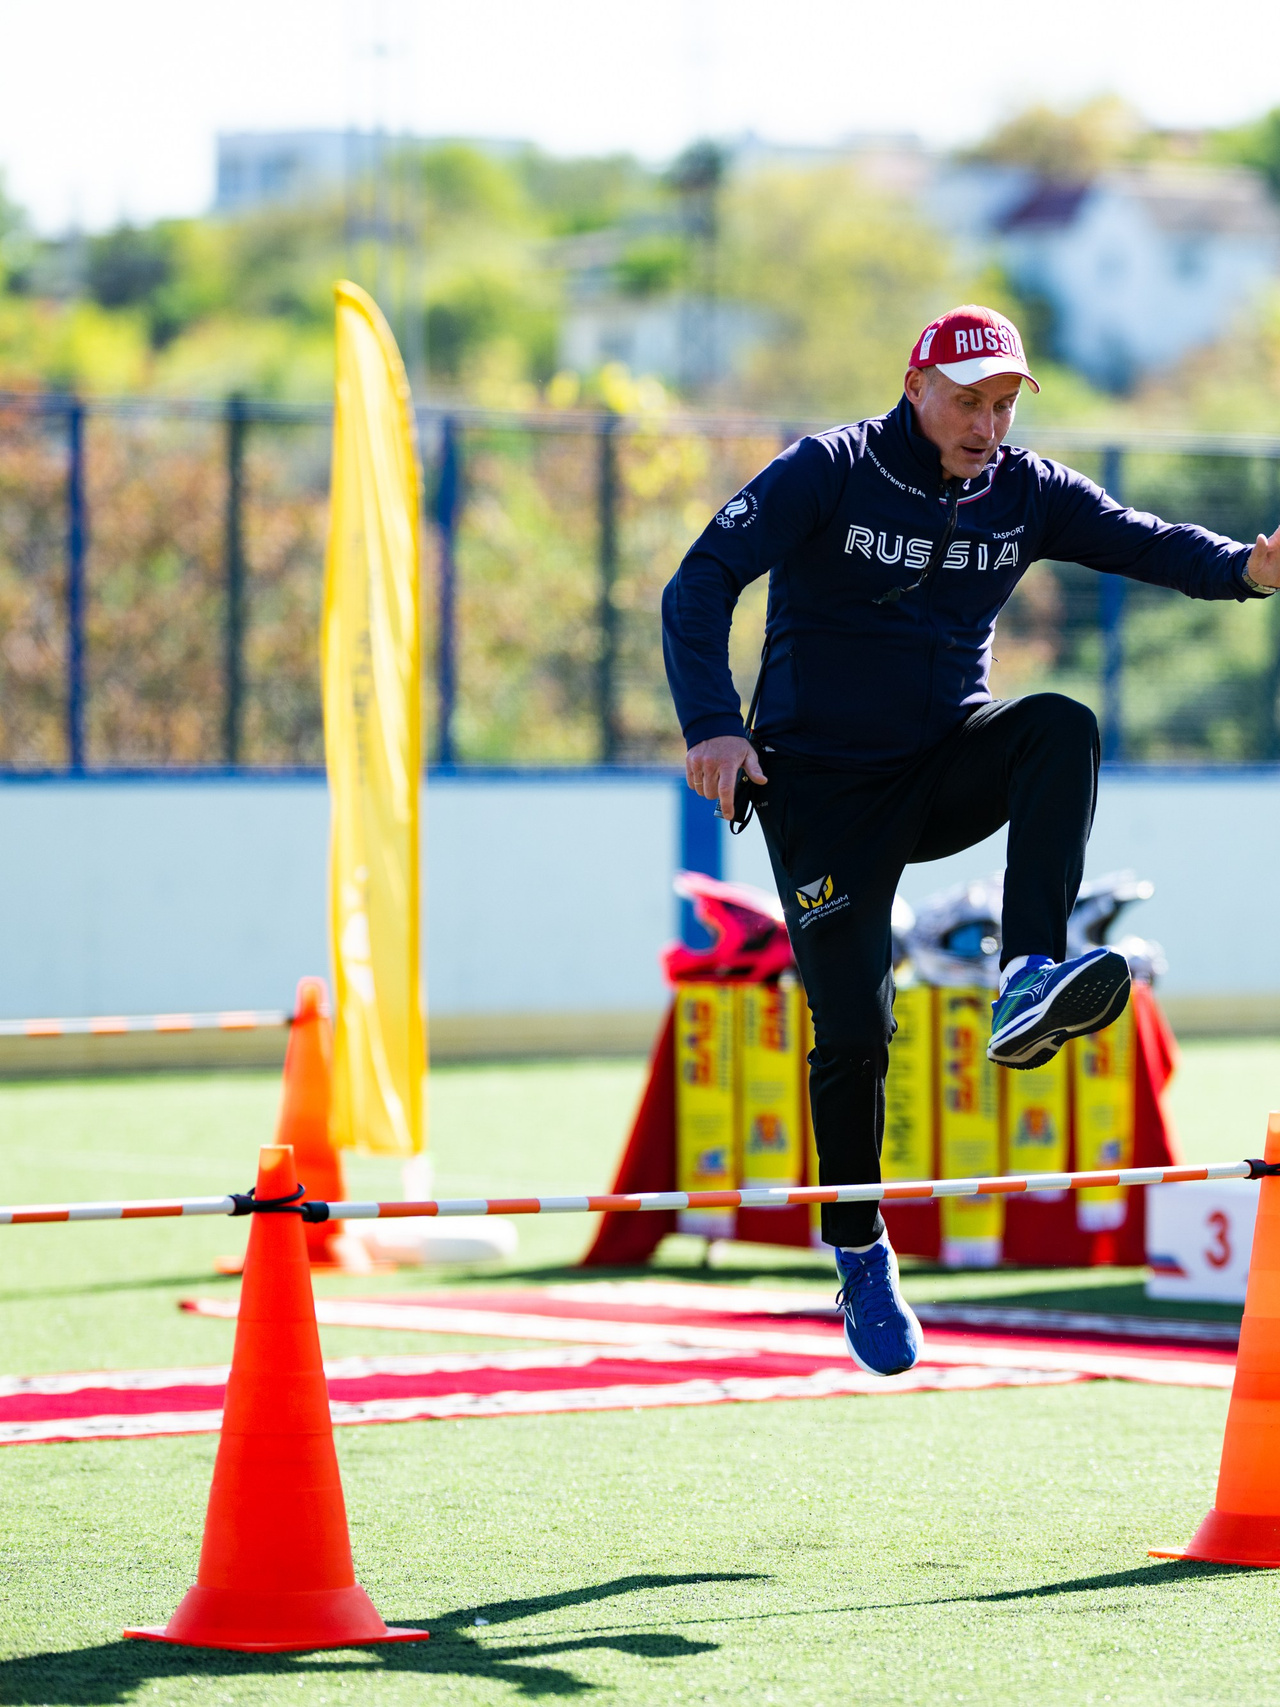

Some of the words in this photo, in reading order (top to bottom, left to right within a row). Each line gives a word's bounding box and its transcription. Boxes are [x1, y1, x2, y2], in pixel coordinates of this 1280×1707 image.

[879, 466, 906, 490] OLYMPIC
[844, 524, 1019, 570] RUSSIA
[992, 525, 1025, 540] ZASPORT
[1204, 1208, 1232, 1272] 3
